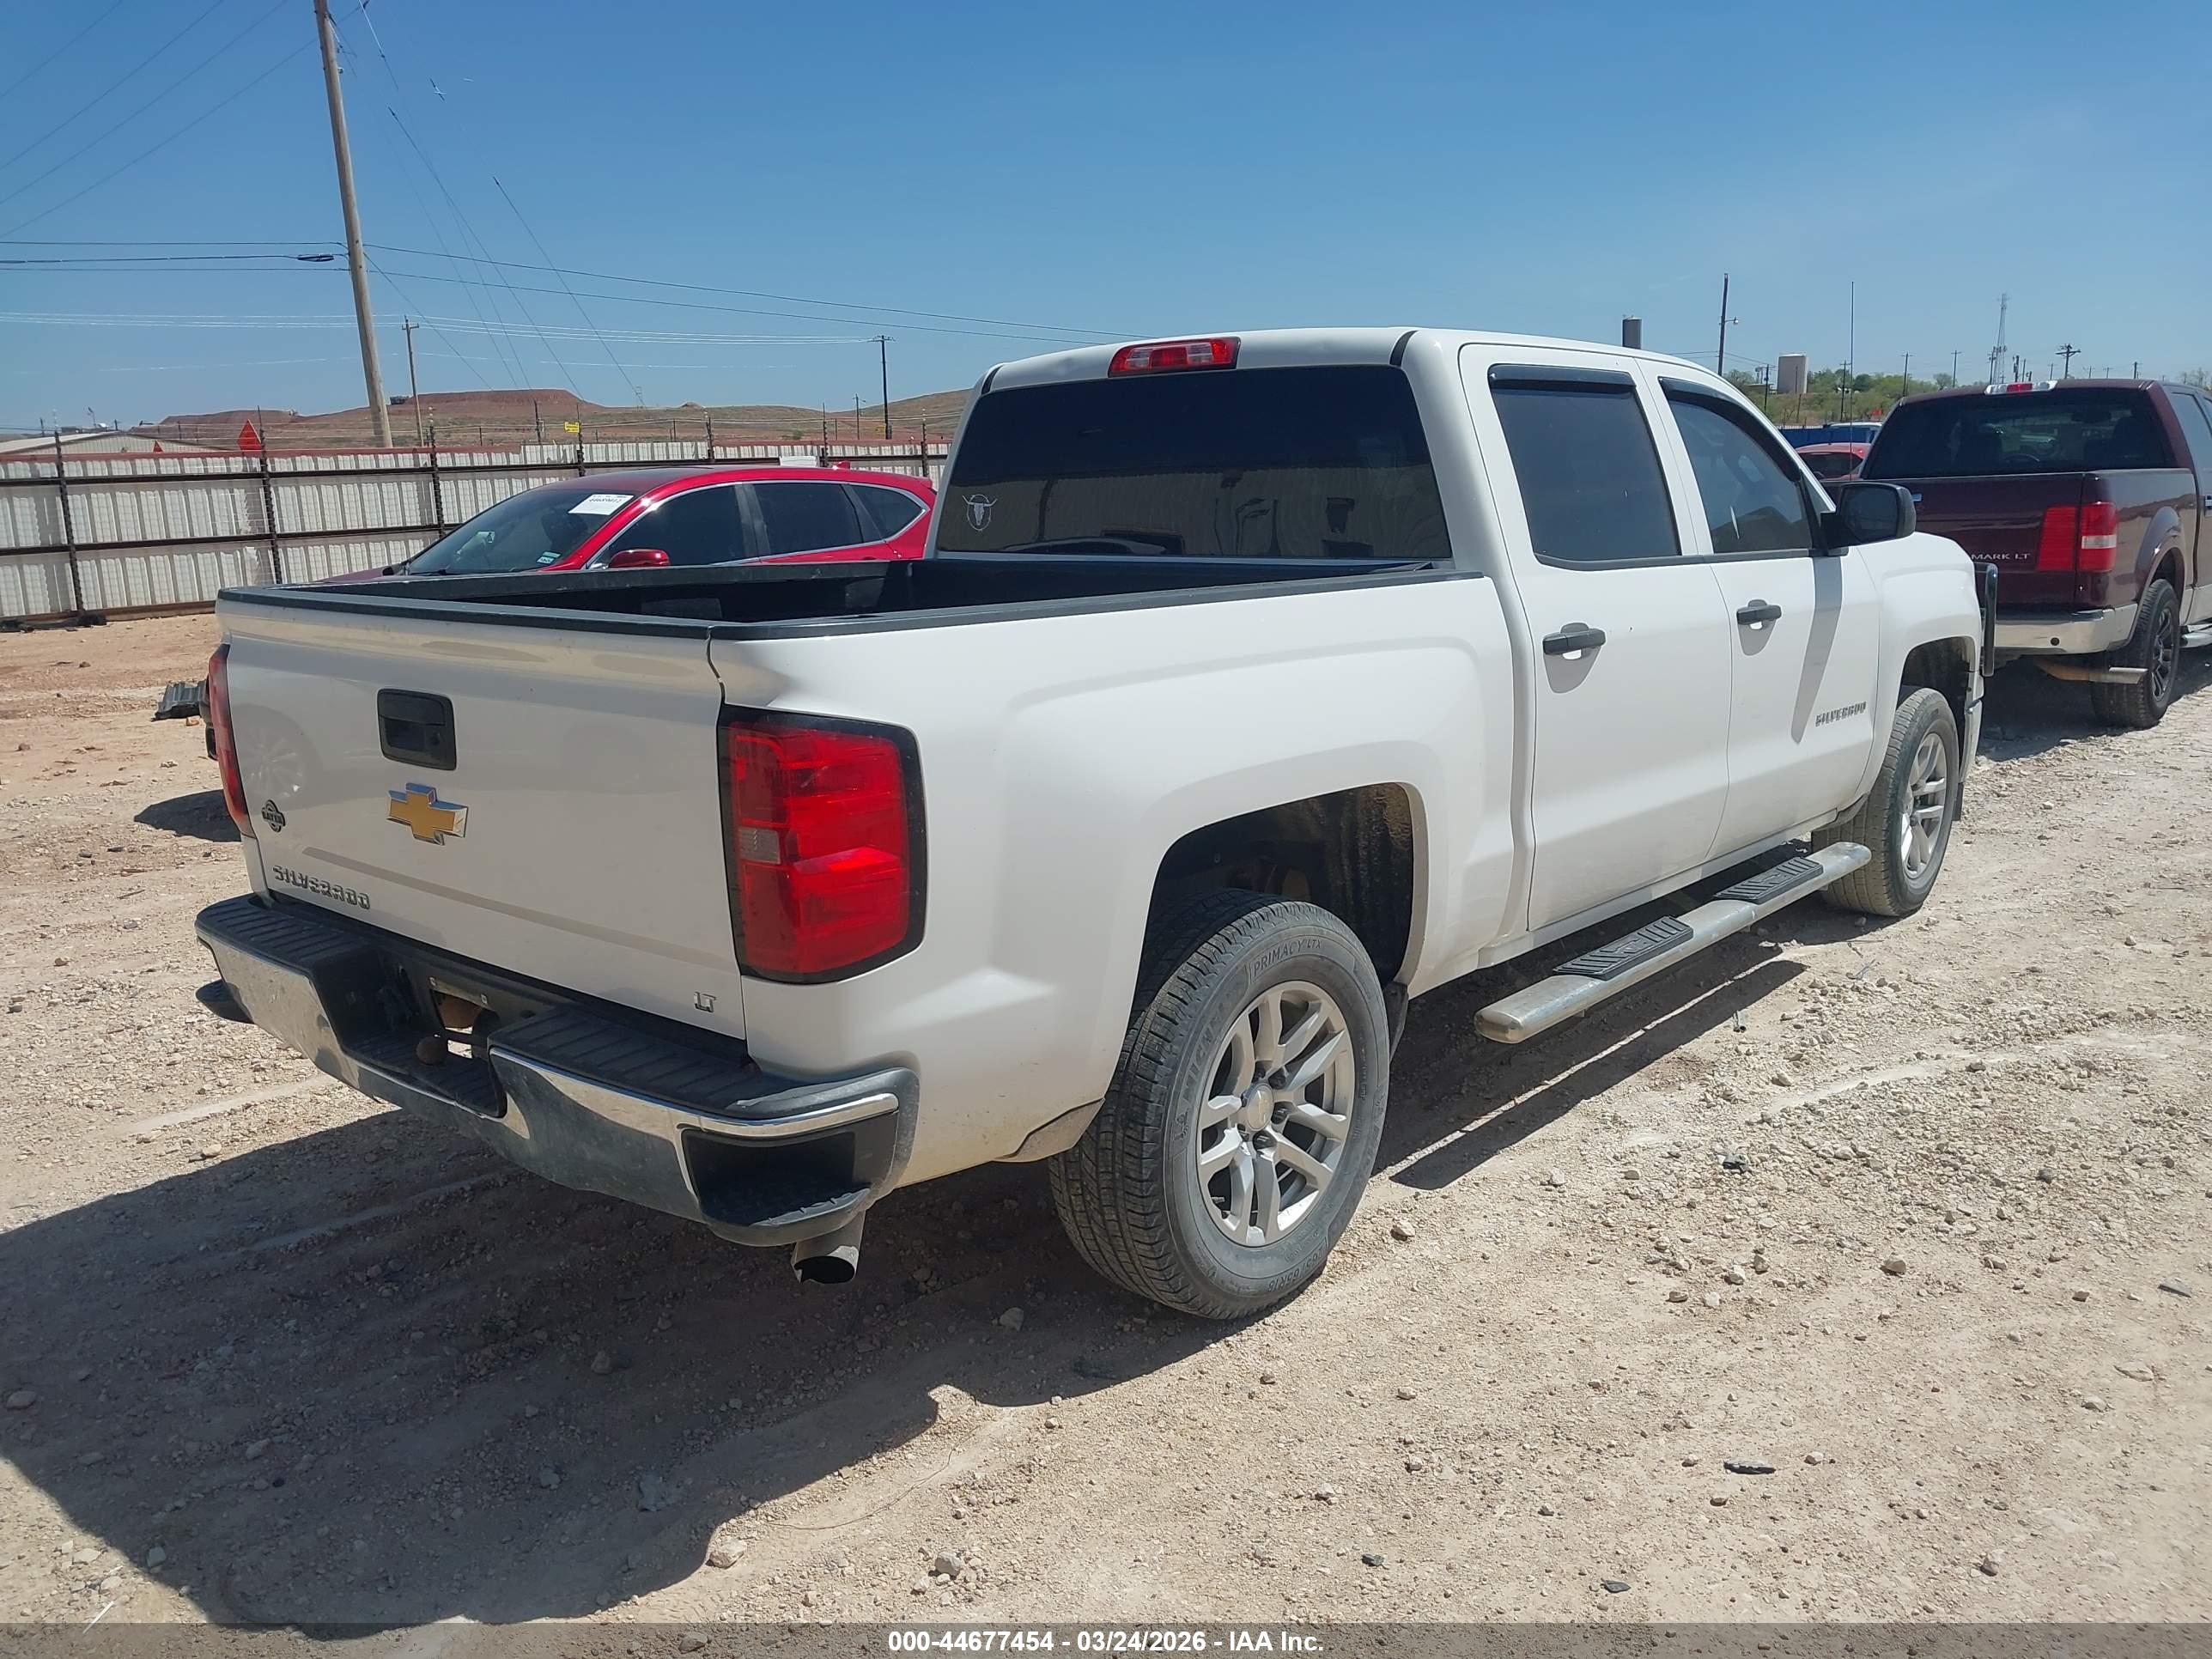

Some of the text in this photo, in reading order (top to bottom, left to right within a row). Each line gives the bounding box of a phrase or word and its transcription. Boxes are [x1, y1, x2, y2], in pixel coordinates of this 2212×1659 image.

[272, 865, 371, 910] SILVERADO
[1253, 939, 1322, 977] PRIMACY LTX
[694, 990, 717, 1013] LT
